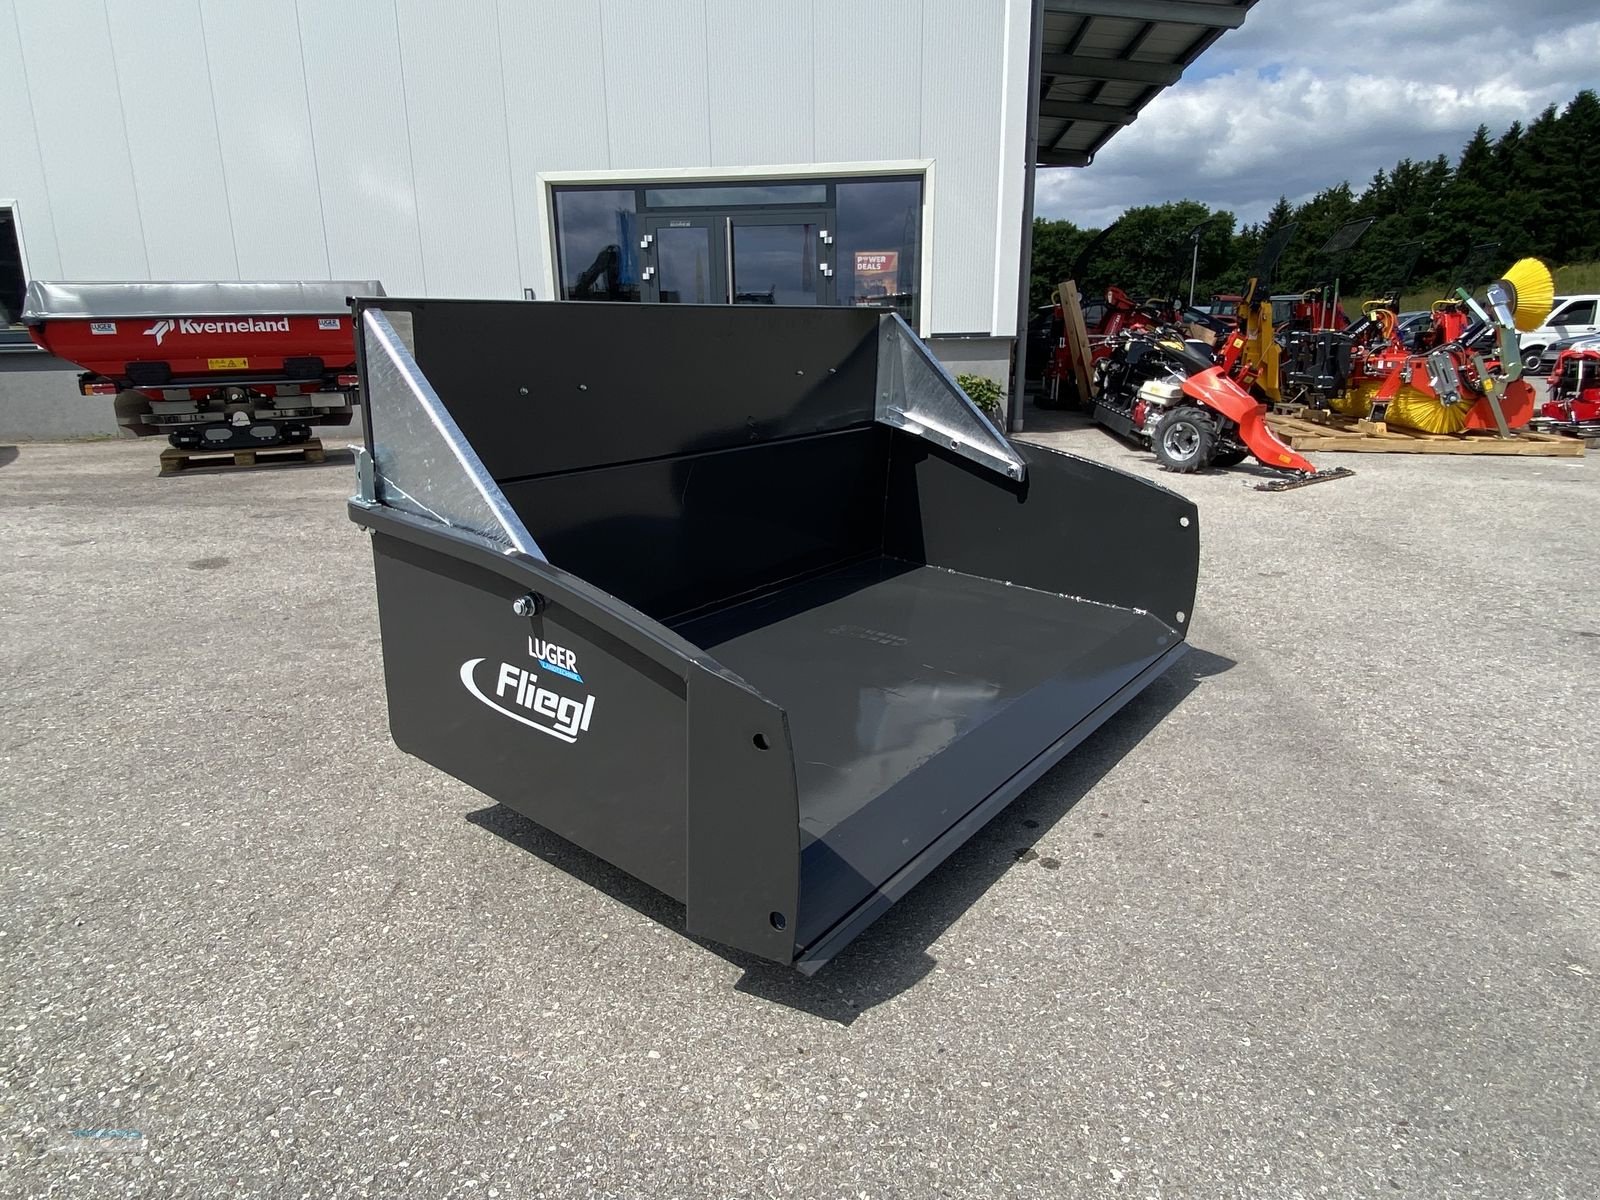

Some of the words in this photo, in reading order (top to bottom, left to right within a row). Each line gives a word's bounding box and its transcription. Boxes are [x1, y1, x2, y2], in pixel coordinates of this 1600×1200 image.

[179, 318, 290, 334] Kverneland
[528, 636, 578, 674] LUGER
[496, 662, 596, 737] Fliegl
